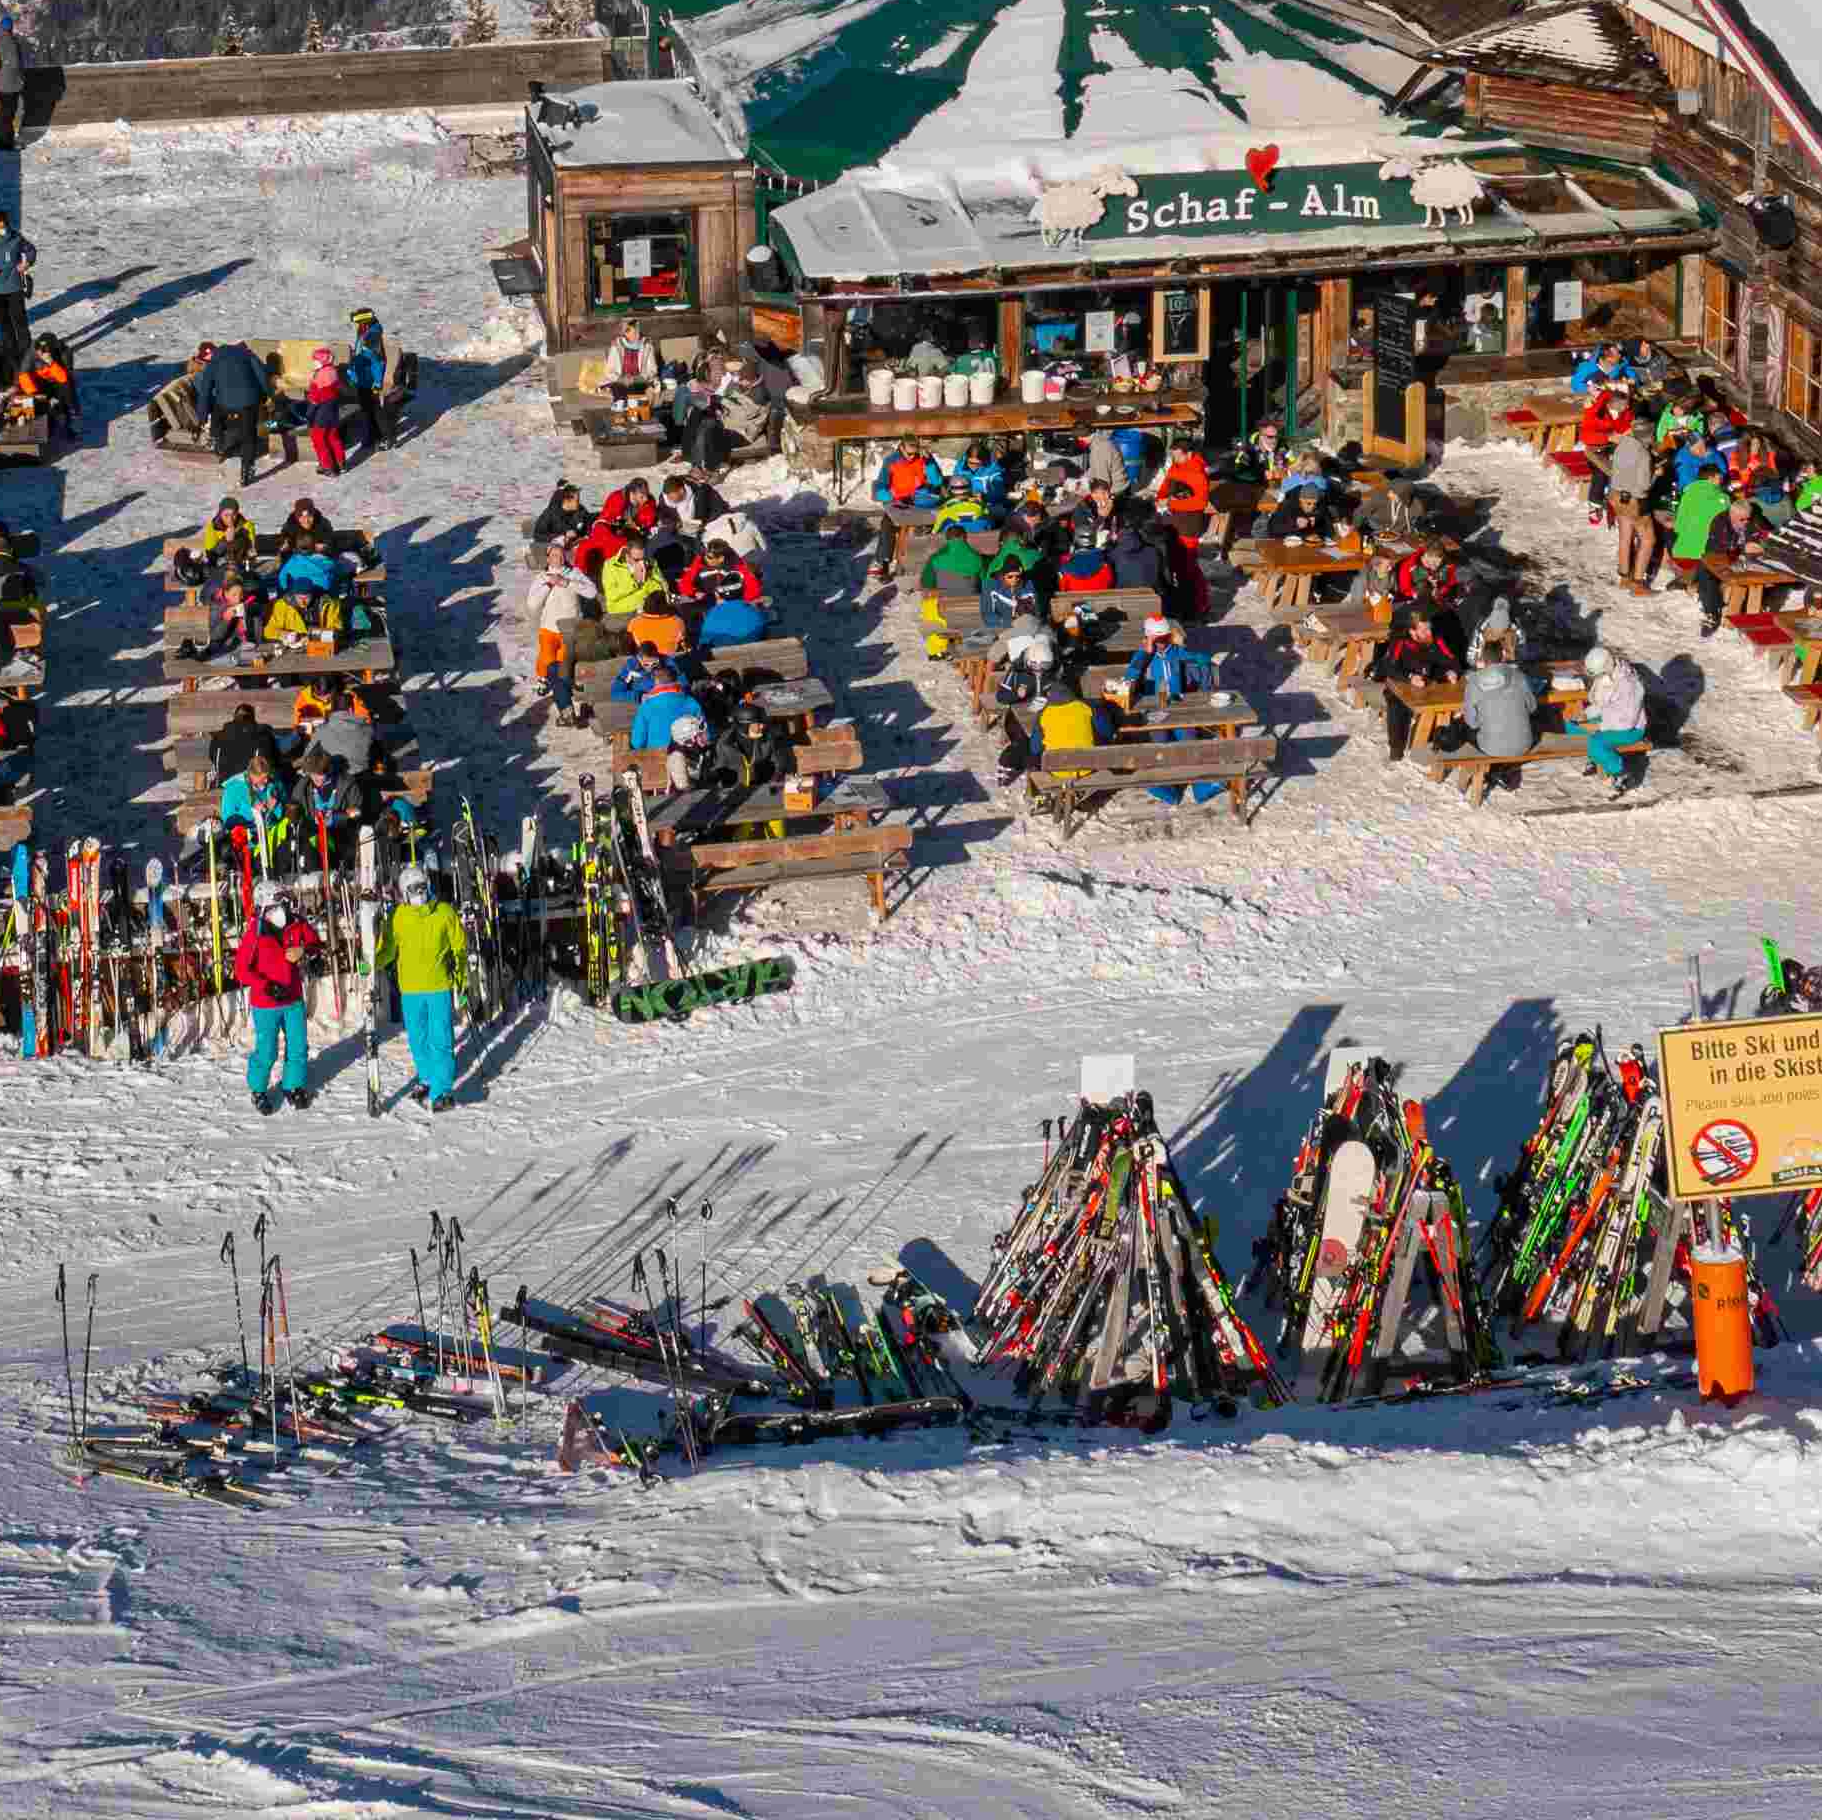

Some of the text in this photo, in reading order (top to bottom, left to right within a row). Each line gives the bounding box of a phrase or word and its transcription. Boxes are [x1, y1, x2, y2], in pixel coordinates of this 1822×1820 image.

[1128, 188, 1256, 233] Schaf
[1300, 185, 1381, 220] Alm
[1691, 1040, 1737, 1061] Bitte
[1745, 1034, 1776, 1056] Ski
[1783, 1029, 1820, 1052] und
[1710, 1065, 1728, 1084] in
[1736, 1060, 1767, 1082] die
